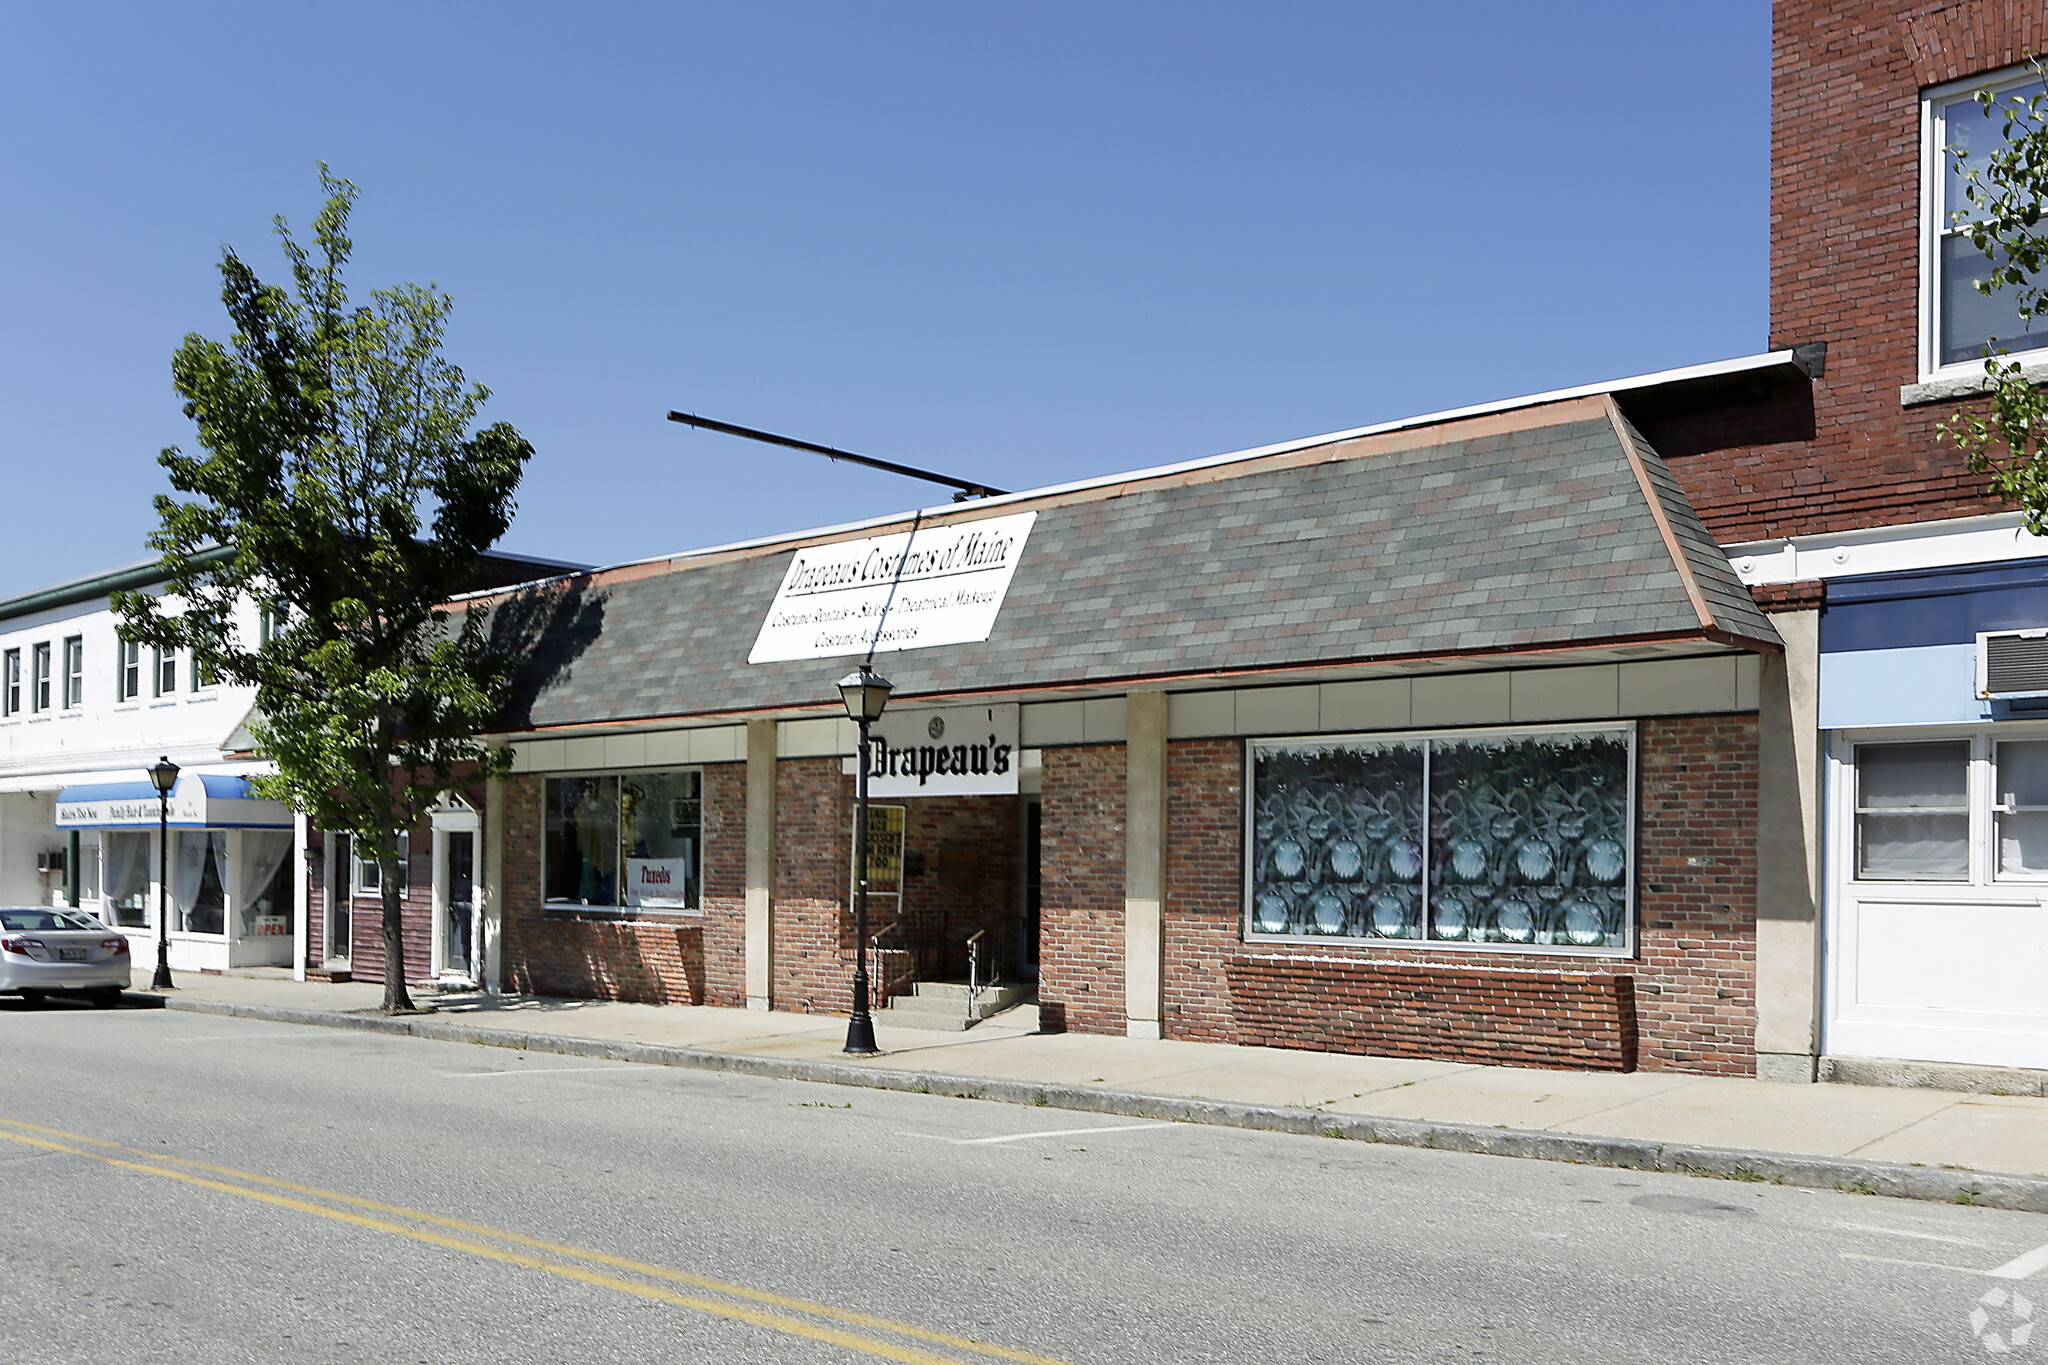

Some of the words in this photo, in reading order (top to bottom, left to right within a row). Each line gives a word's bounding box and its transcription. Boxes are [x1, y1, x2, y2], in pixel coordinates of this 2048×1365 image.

[862, 547, 938, 581] Costumes
[939, 535, 964, 570] of
[957, 531, 1013, 567] Maine
[772, 611, 812, 627] Costume
[812, 605, 849, 623] Rentals
[858, 601, 888, 619] Sales
[898, 592, 953, 614] Theatrical
[952, 589, 996, 607] Makeup
[815, 631, 856, 648] Costume
[857, 627, 919, 646] Accessories
[868, 733, 1012, 786] Drapeau's
[877, 845, 901, 856] RENT
[641, 864, 671, 884] Tuxedos
[257, 923, 284, 936] OPEN
